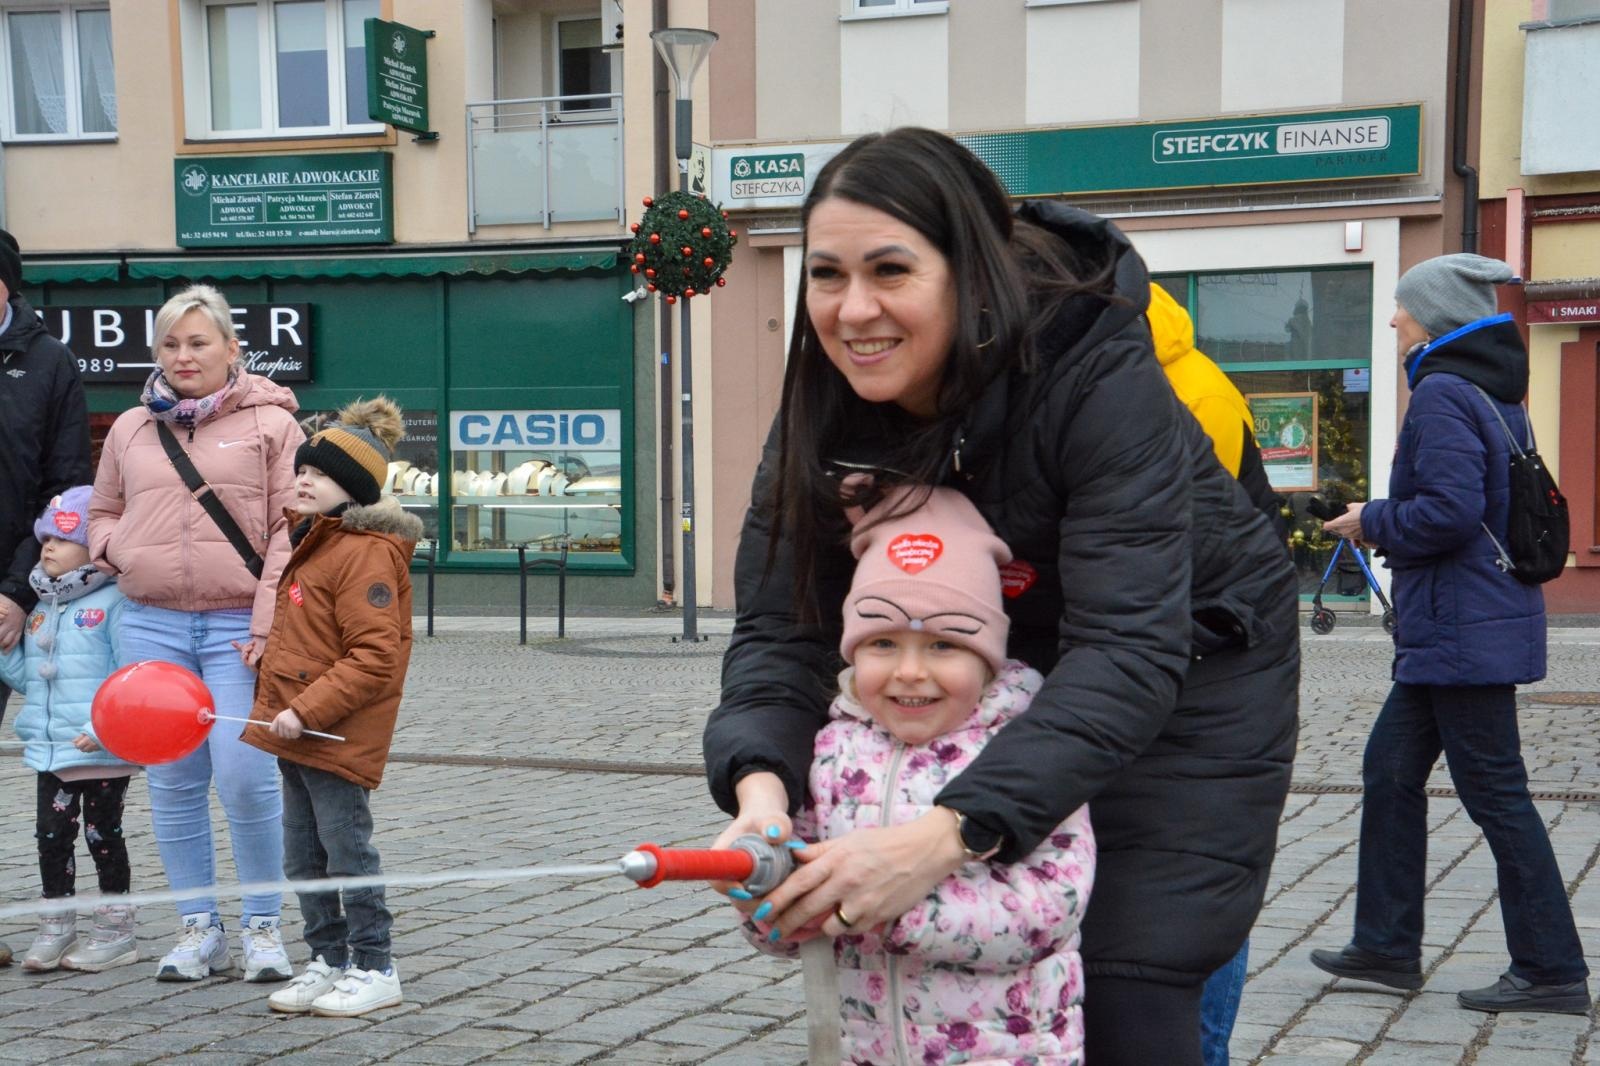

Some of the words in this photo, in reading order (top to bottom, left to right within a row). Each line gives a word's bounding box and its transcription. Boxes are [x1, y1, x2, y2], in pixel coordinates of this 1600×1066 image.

[1162, 131, 1270, 156] STEFCZYK
[1283, 125, 1379, 148] FINANSE
[754, 159, 800, 174] KASA
[1315, 152, 1388, 168] PARTNER
[211, 172, 290, 187] KANCELARIE
[292, 169, 380, 184] ADWOKACKIE
[330, 192, 352, 200] Stefan
[354, 191, 380, 200] Zientek
[735, 181, 801, 196] STEFCZYKA
[237, 195, 262, 203] Zientek
[267, 194, 296, 205] Patrycja
[297, 194, 327, 202] Mazurek
[338, 202, 374, 210] ADWOKAT
[220, 206, 255, 214] ADWOKAT
[280, 205, 316, 213] ADWOKAT
[1560, 306, 1596, 316] SMAKI
[77, 358, 114, 372] 989
[244, 350, 302, 378] Karpisz
[459, 414, 606, 446] CASIO
